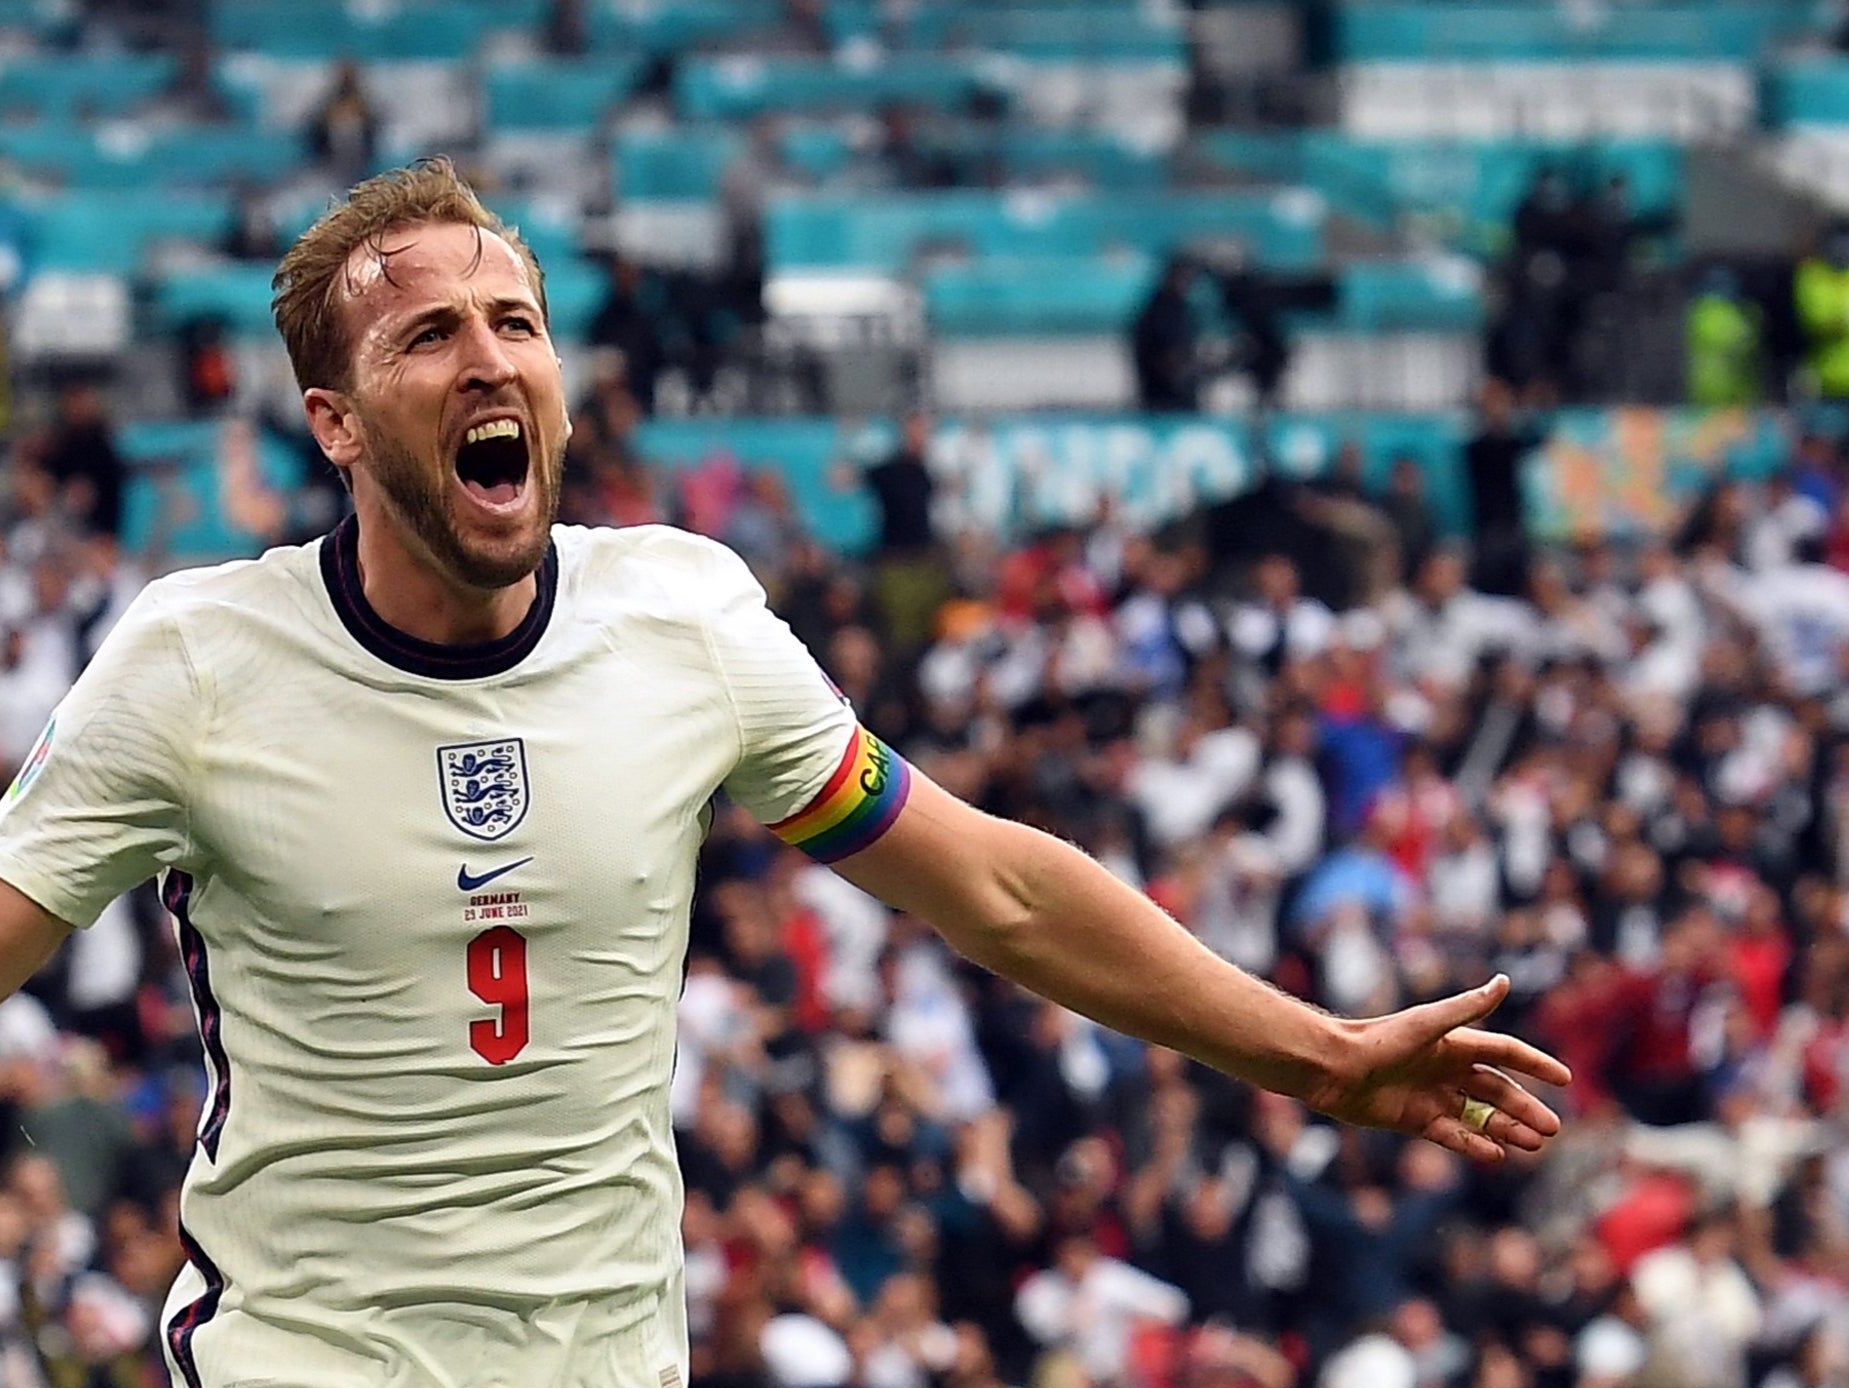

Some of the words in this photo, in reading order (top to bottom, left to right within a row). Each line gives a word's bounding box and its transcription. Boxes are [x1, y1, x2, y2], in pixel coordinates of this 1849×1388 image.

[470, 891, 521, 907] GERMANY
[464, 908, 477, 921] 29
[479, 906, 505, 920] JUNE
[506, 904, 529, 918] 2021
[466, 924, 530, 1066] 9
